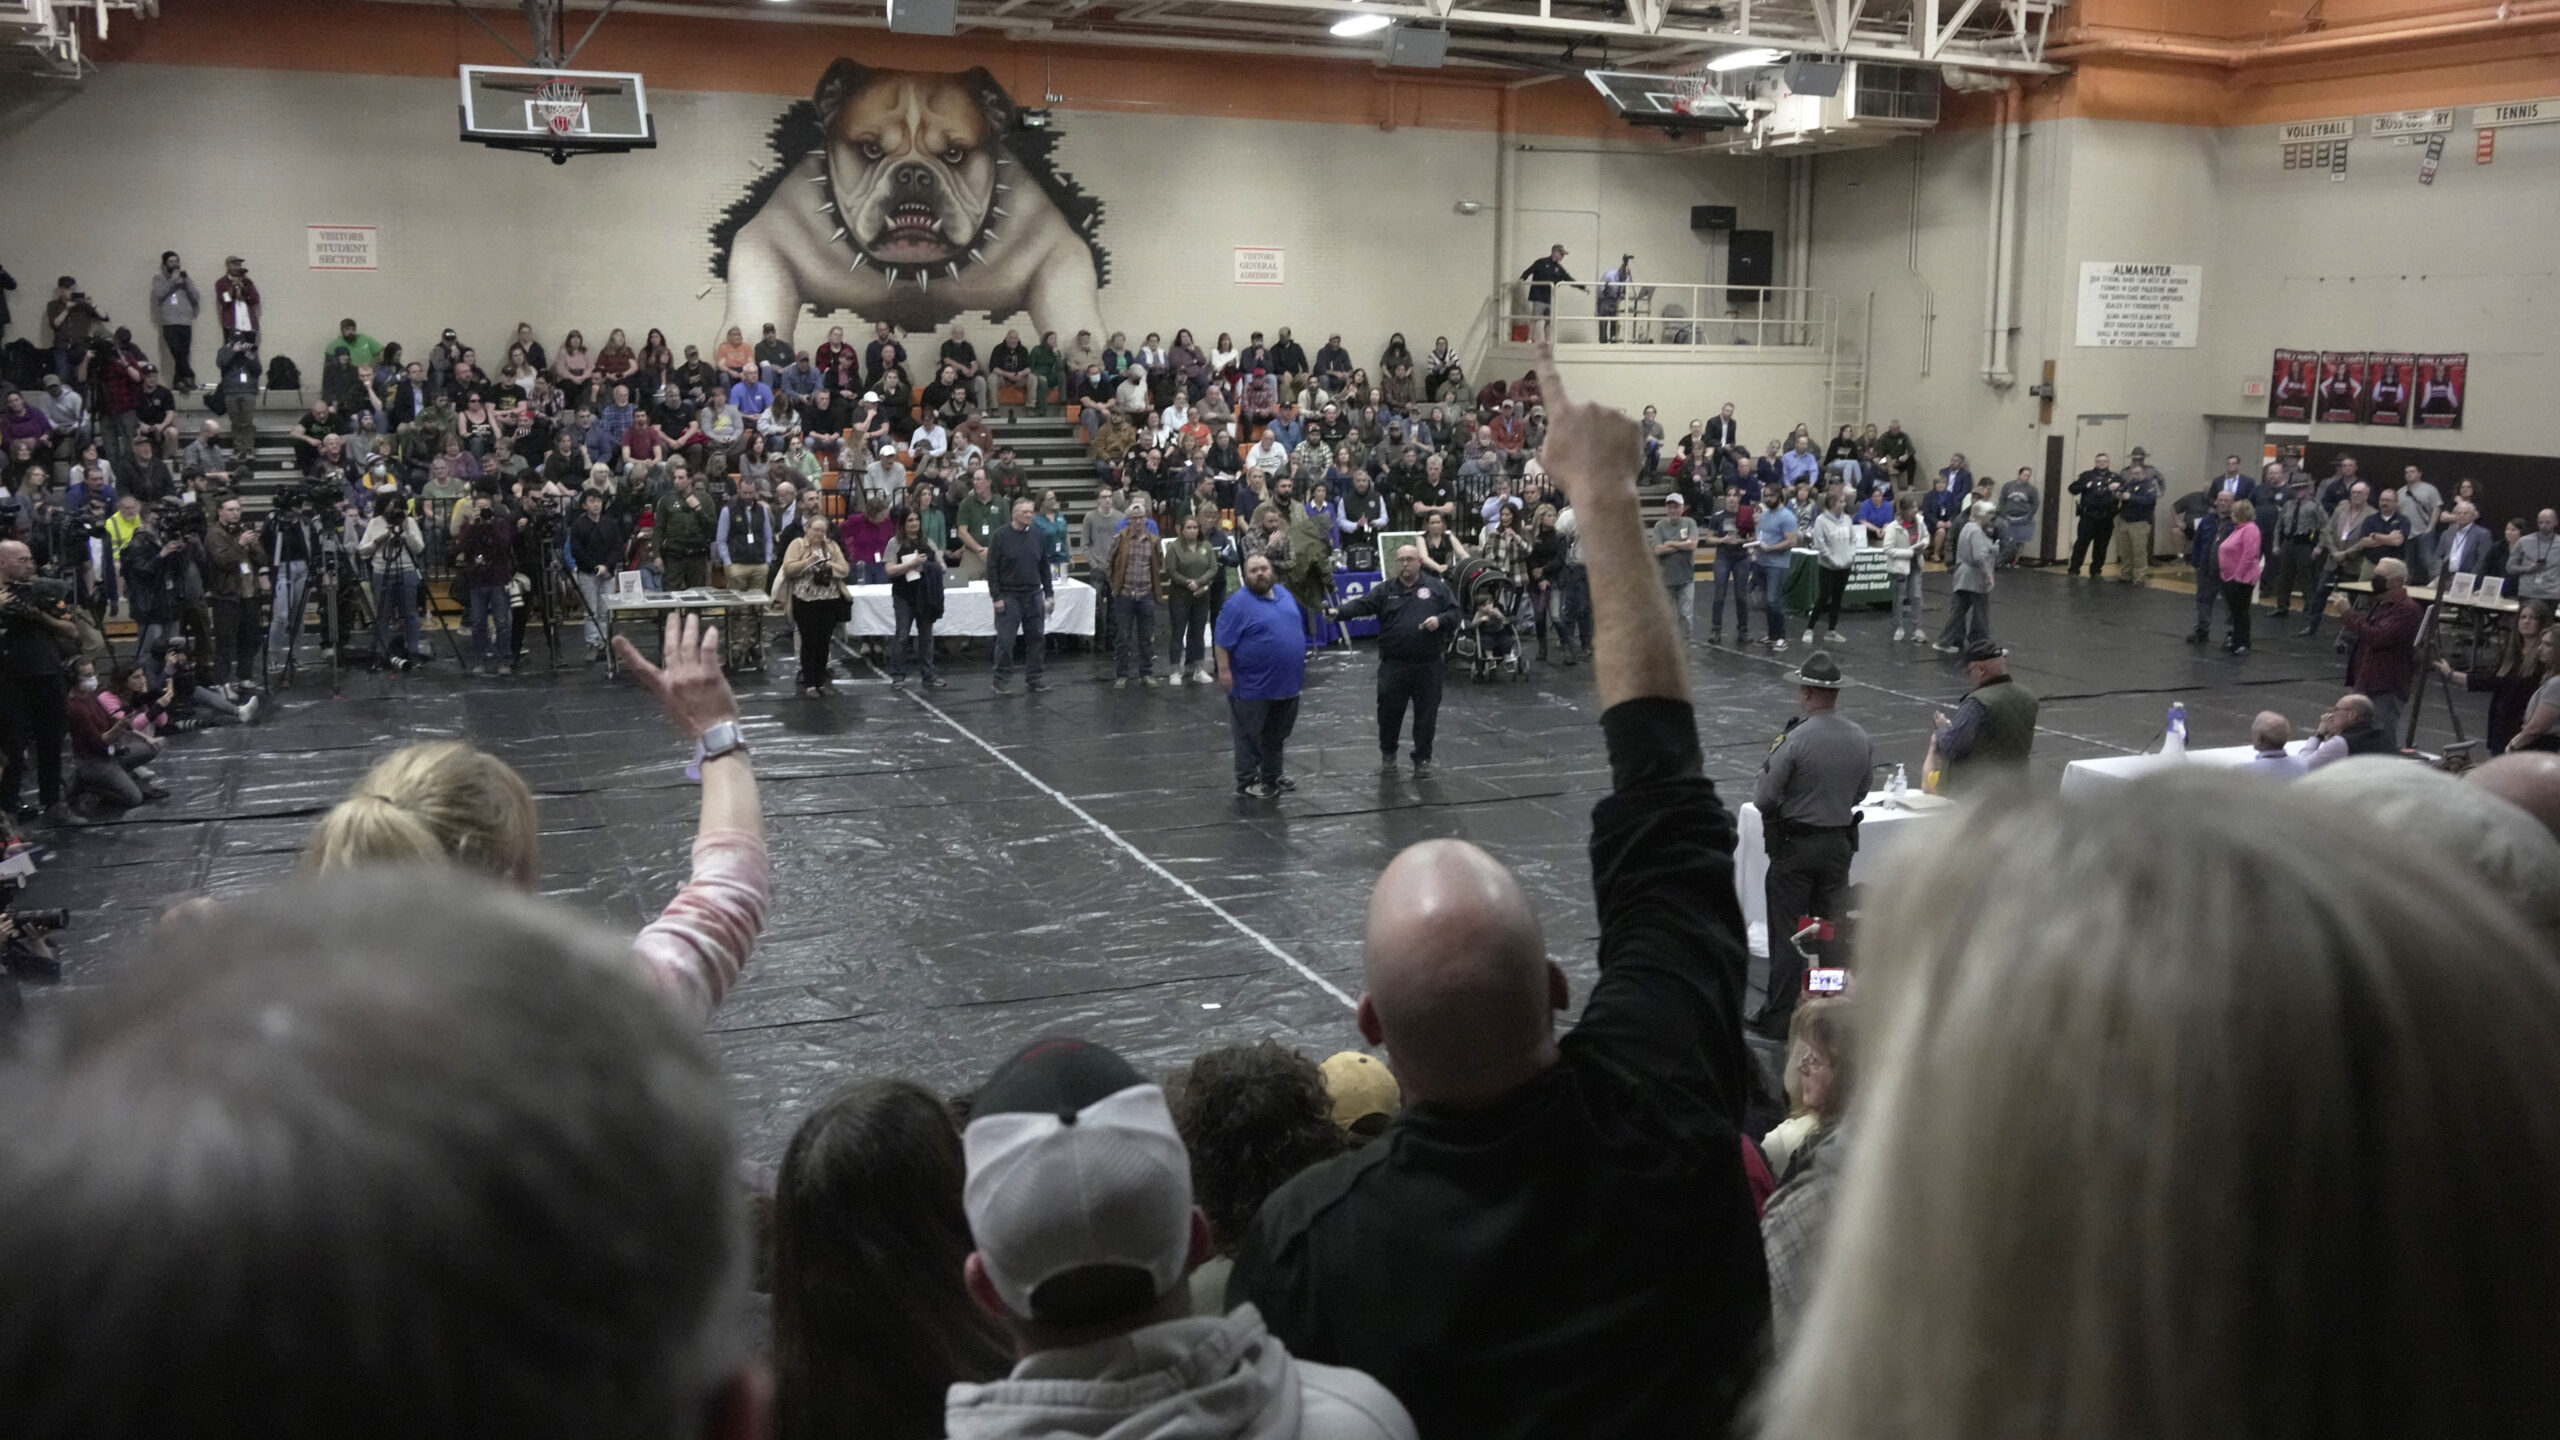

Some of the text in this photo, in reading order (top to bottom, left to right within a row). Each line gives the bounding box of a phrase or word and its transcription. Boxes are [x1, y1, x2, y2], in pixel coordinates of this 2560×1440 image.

[2496, 104, 2538, 120] TENNIS
[2286, 122, 2346, 138] VOLLEYBALL
[316, 244, 368, 252] STUDENT
[318, 255, 366, 264] SECTION
[2113, 265, 2171, 276] ALMA MATER
[1870, 581, 1891, 589] Board
